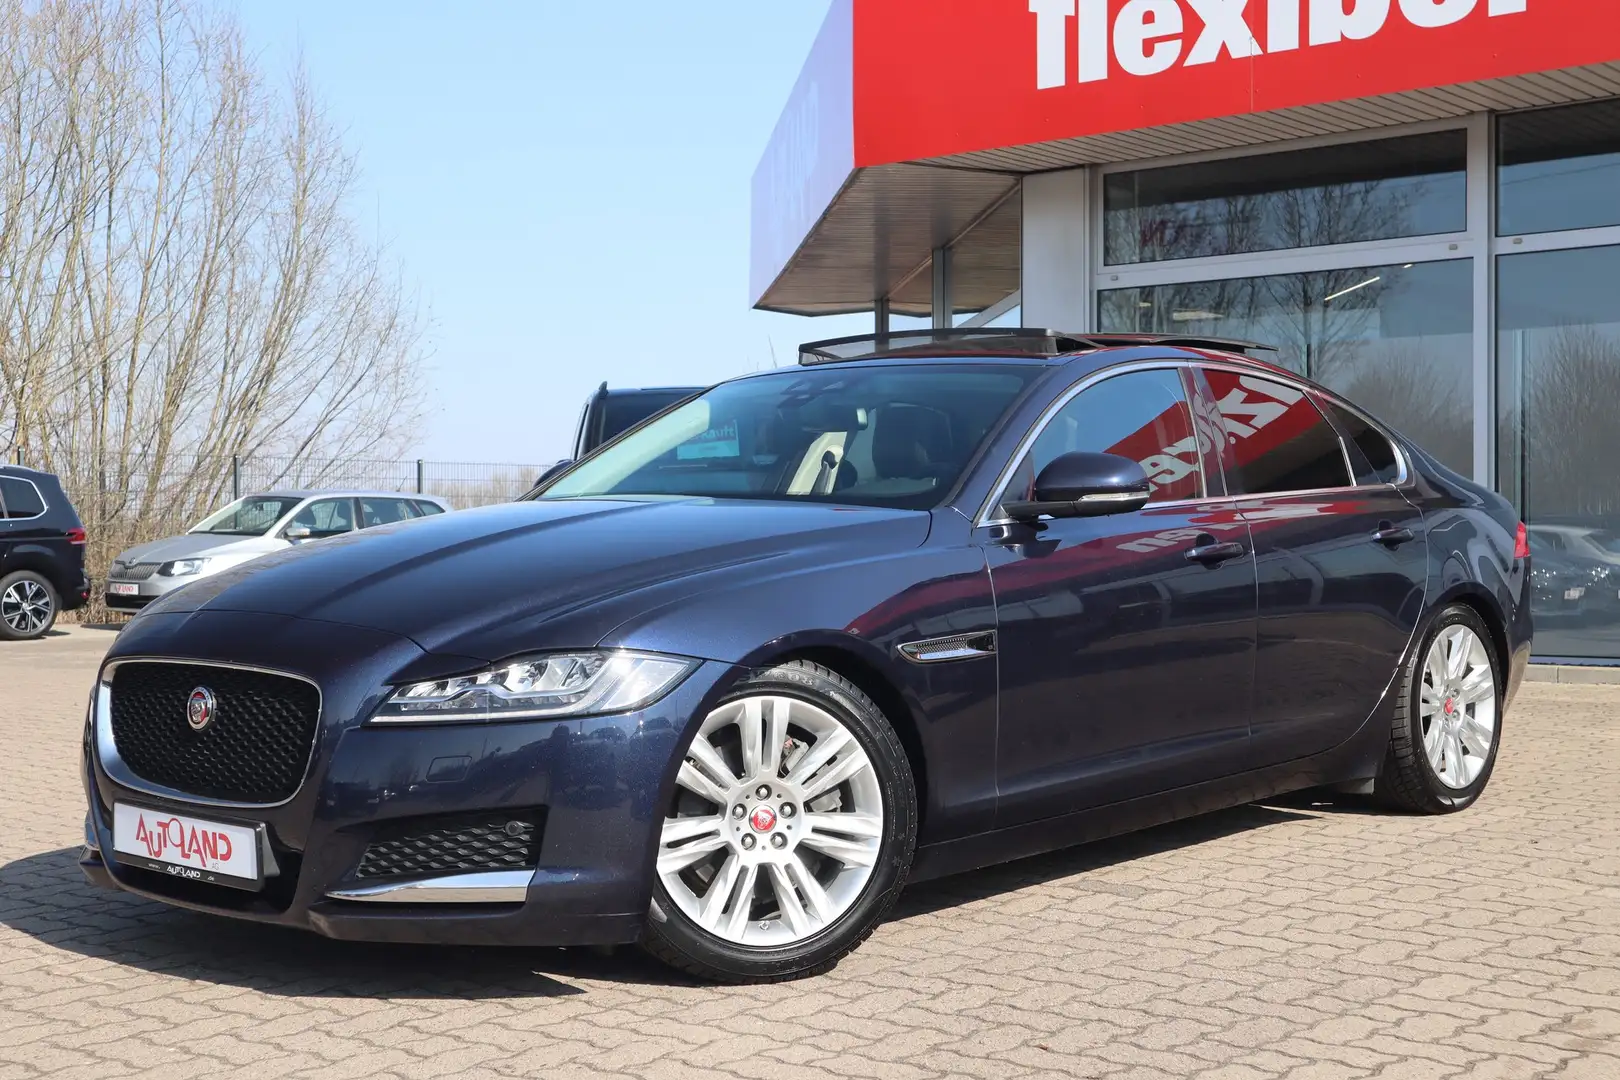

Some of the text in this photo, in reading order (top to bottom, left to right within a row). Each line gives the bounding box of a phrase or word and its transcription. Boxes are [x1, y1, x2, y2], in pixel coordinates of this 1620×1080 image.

[1028, 0, 1527, 90] flex
[136, 812, 232, 868] AUTOLAND
[166, 865, 201, 878] AUTOLAND
